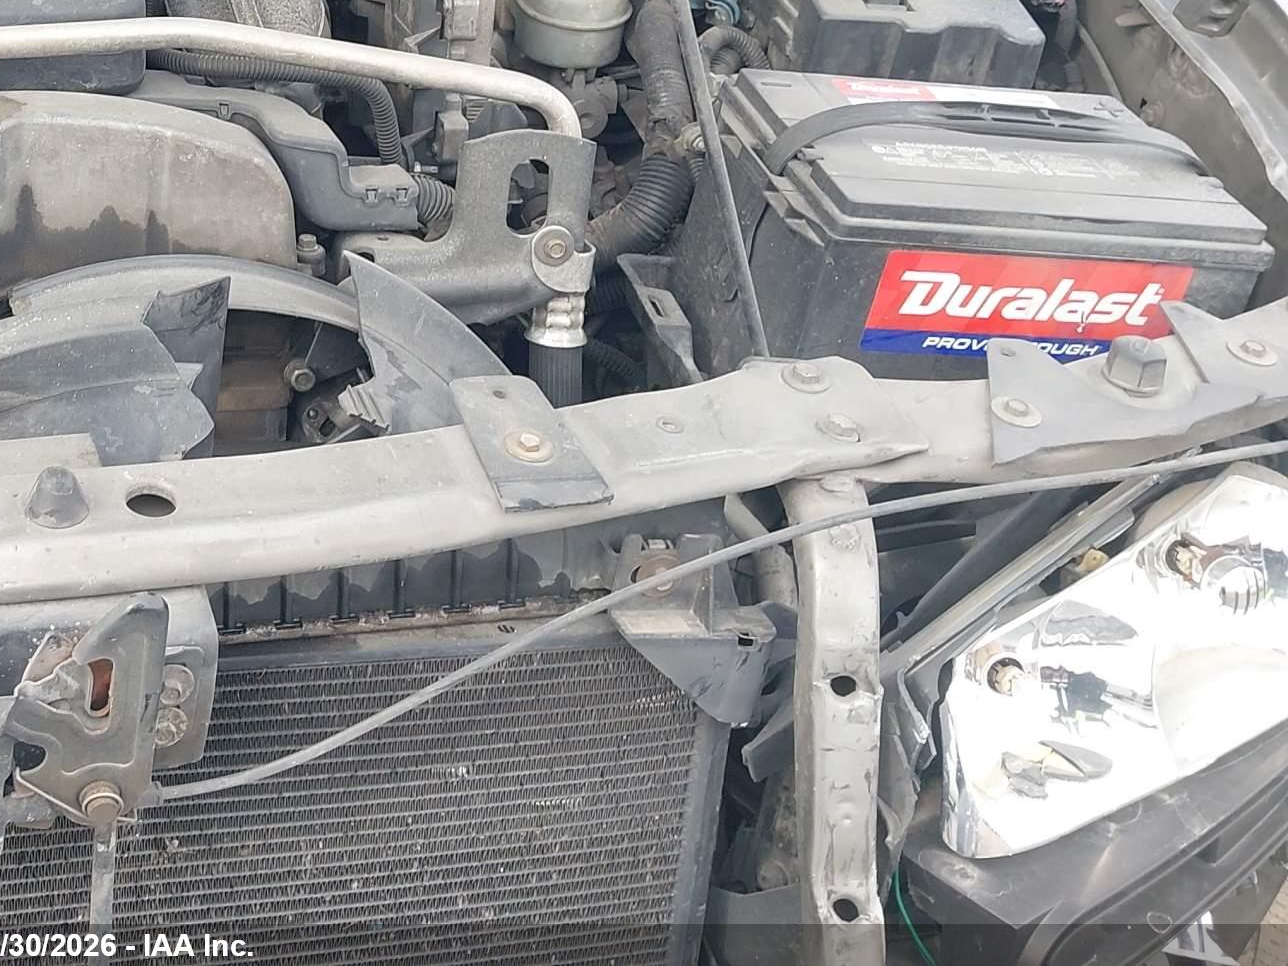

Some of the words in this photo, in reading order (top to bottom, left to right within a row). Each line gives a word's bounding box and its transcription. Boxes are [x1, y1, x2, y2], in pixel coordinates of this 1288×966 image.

[898, 270, 1164, 326] Duralast
[922, 336, 988, 351] PROV
[1032, 341, 1099, 356] OUGH
